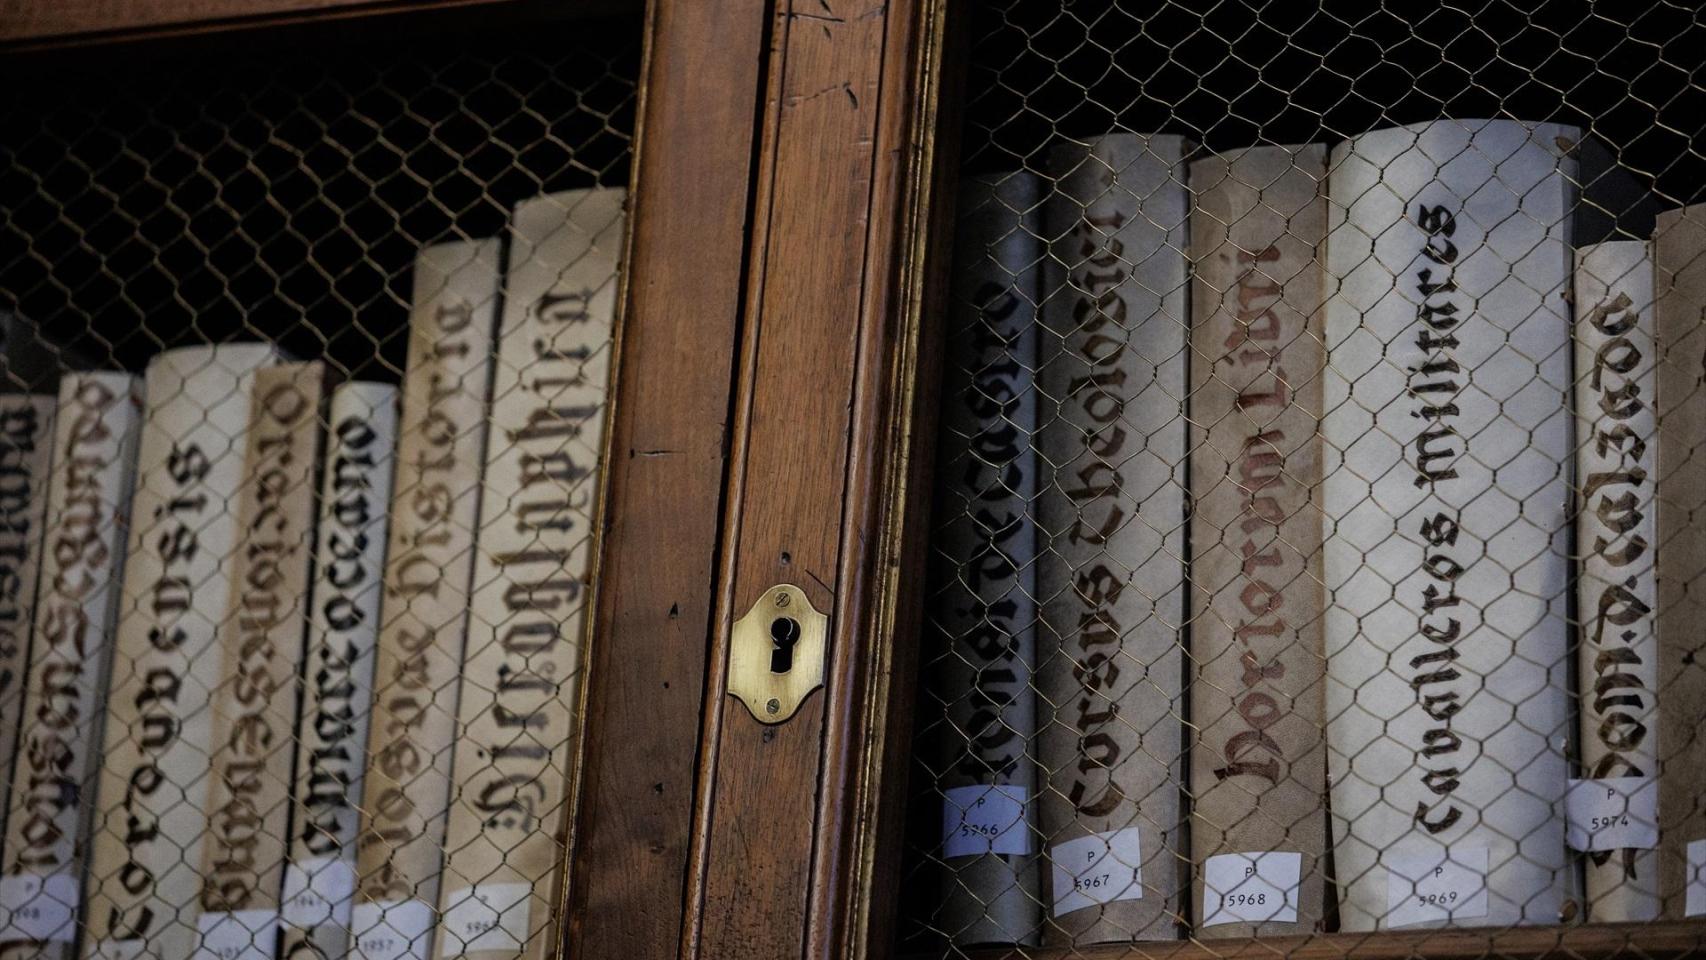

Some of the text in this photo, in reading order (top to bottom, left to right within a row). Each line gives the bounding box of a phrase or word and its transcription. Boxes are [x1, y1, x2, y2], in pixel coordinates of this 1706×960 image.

[1607, 788, 1615, 800] P
[976, 798, 985, 808] P
[1591, 815, 1629, 830] 5974
[961, 823, 999, 837] 5966
[1087, 851, 1095, 862] P
[1245, 867, 1254, 877] P
[1435, 867, 1443, 878] P
[1075, 874, 1110, 892] 5967
[1228, 893, 1267, 907] 5968
[1419, 891, 1458, 907] 5969
